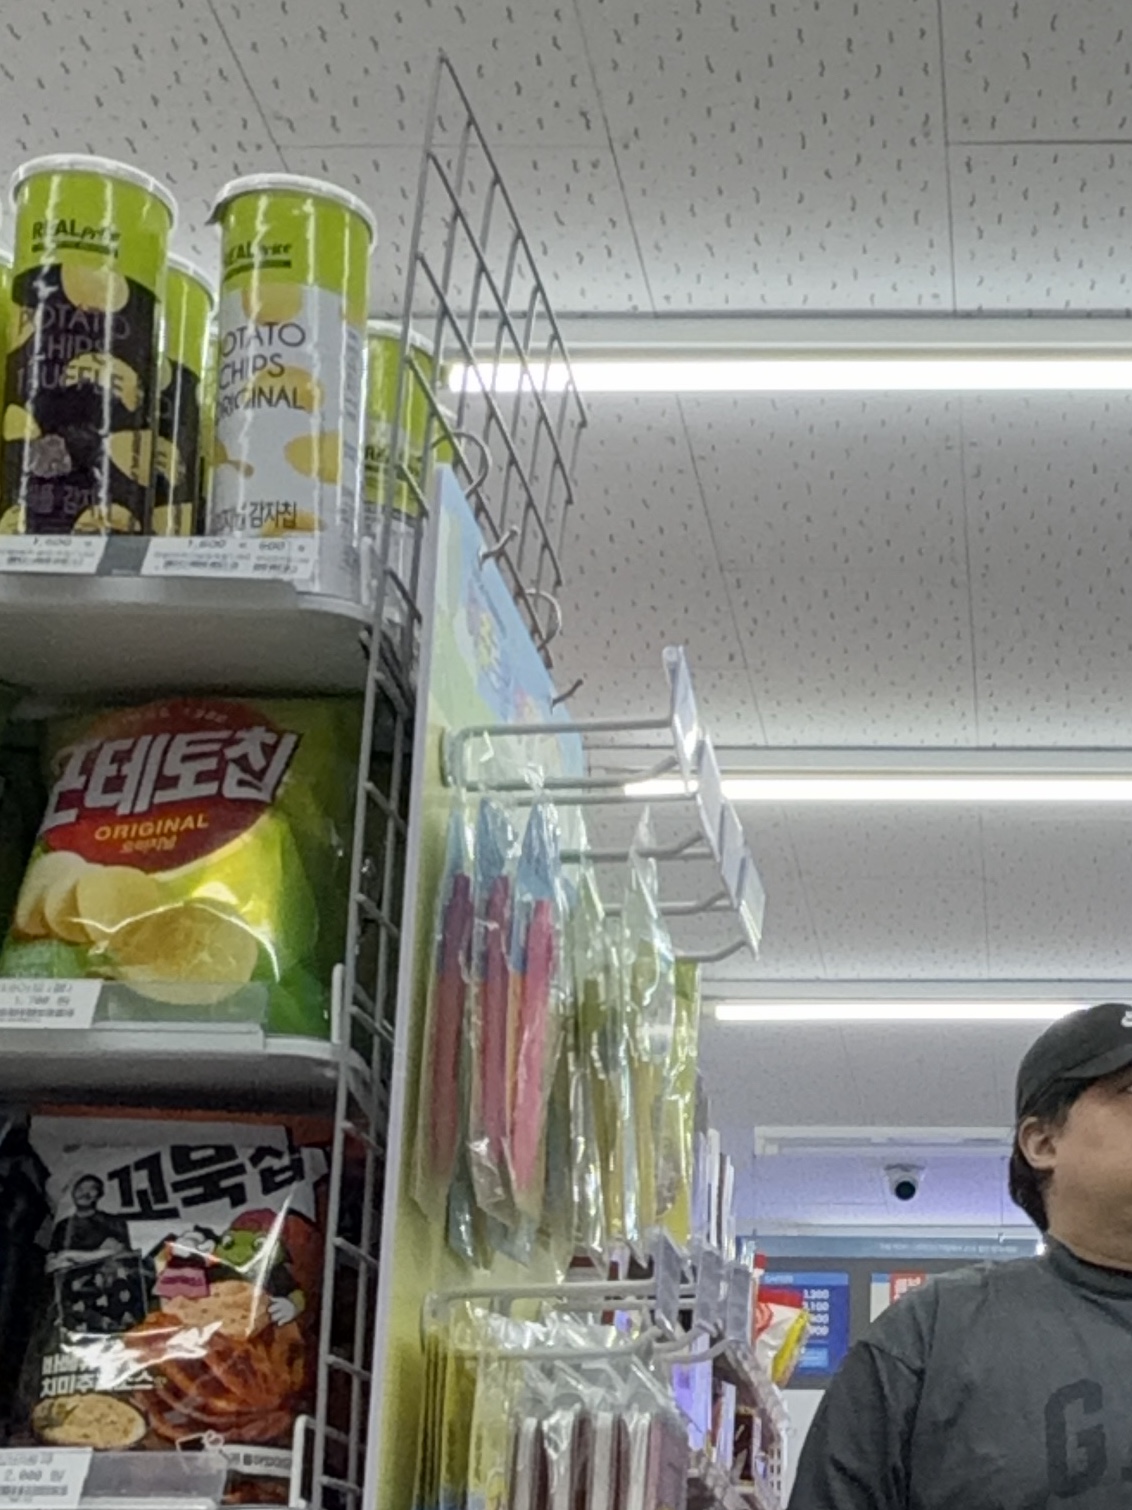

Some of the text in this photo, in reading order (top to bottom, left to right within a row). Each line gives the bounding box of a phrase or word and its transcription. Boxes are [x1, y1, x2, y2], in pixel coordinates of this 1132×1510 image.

[220, 321, 306, 358] OTATO
[250, 499, 297, 529] 감자칩
[94, 813, 209, 841] ORIGINAL
